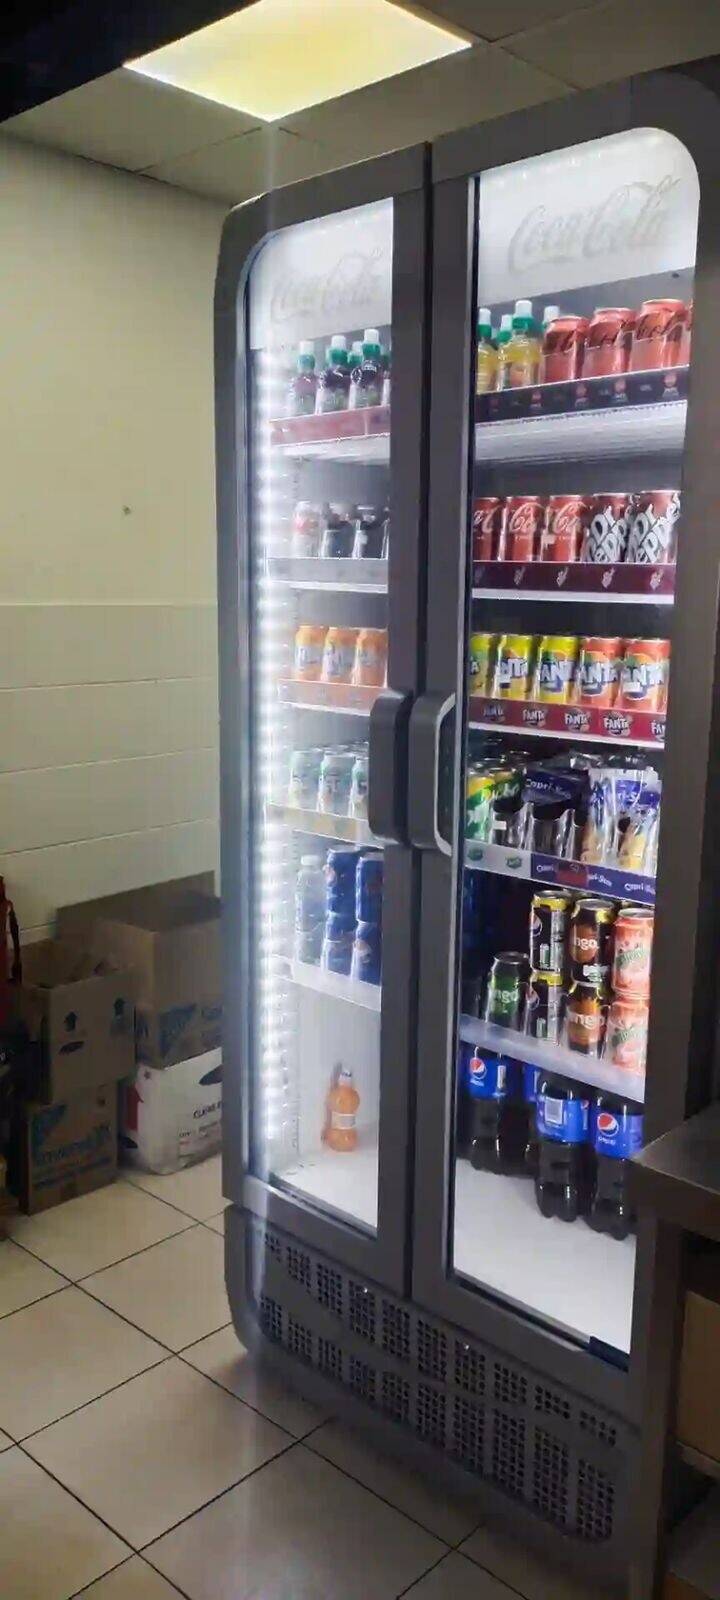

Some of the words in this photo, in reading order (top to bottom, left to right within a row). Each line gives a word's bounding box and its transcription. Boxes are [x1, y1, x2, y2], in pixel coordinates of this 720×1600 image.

[564, 713, 588, 725] FANTA
[603, 717, 630, 730] FANTA
[651, 721, 666, 735] FAN
[575, 937, 599, 950] ngo
[494, 989, 520, 1004] ngo
[575, 1014, 605, 1029] ngo
